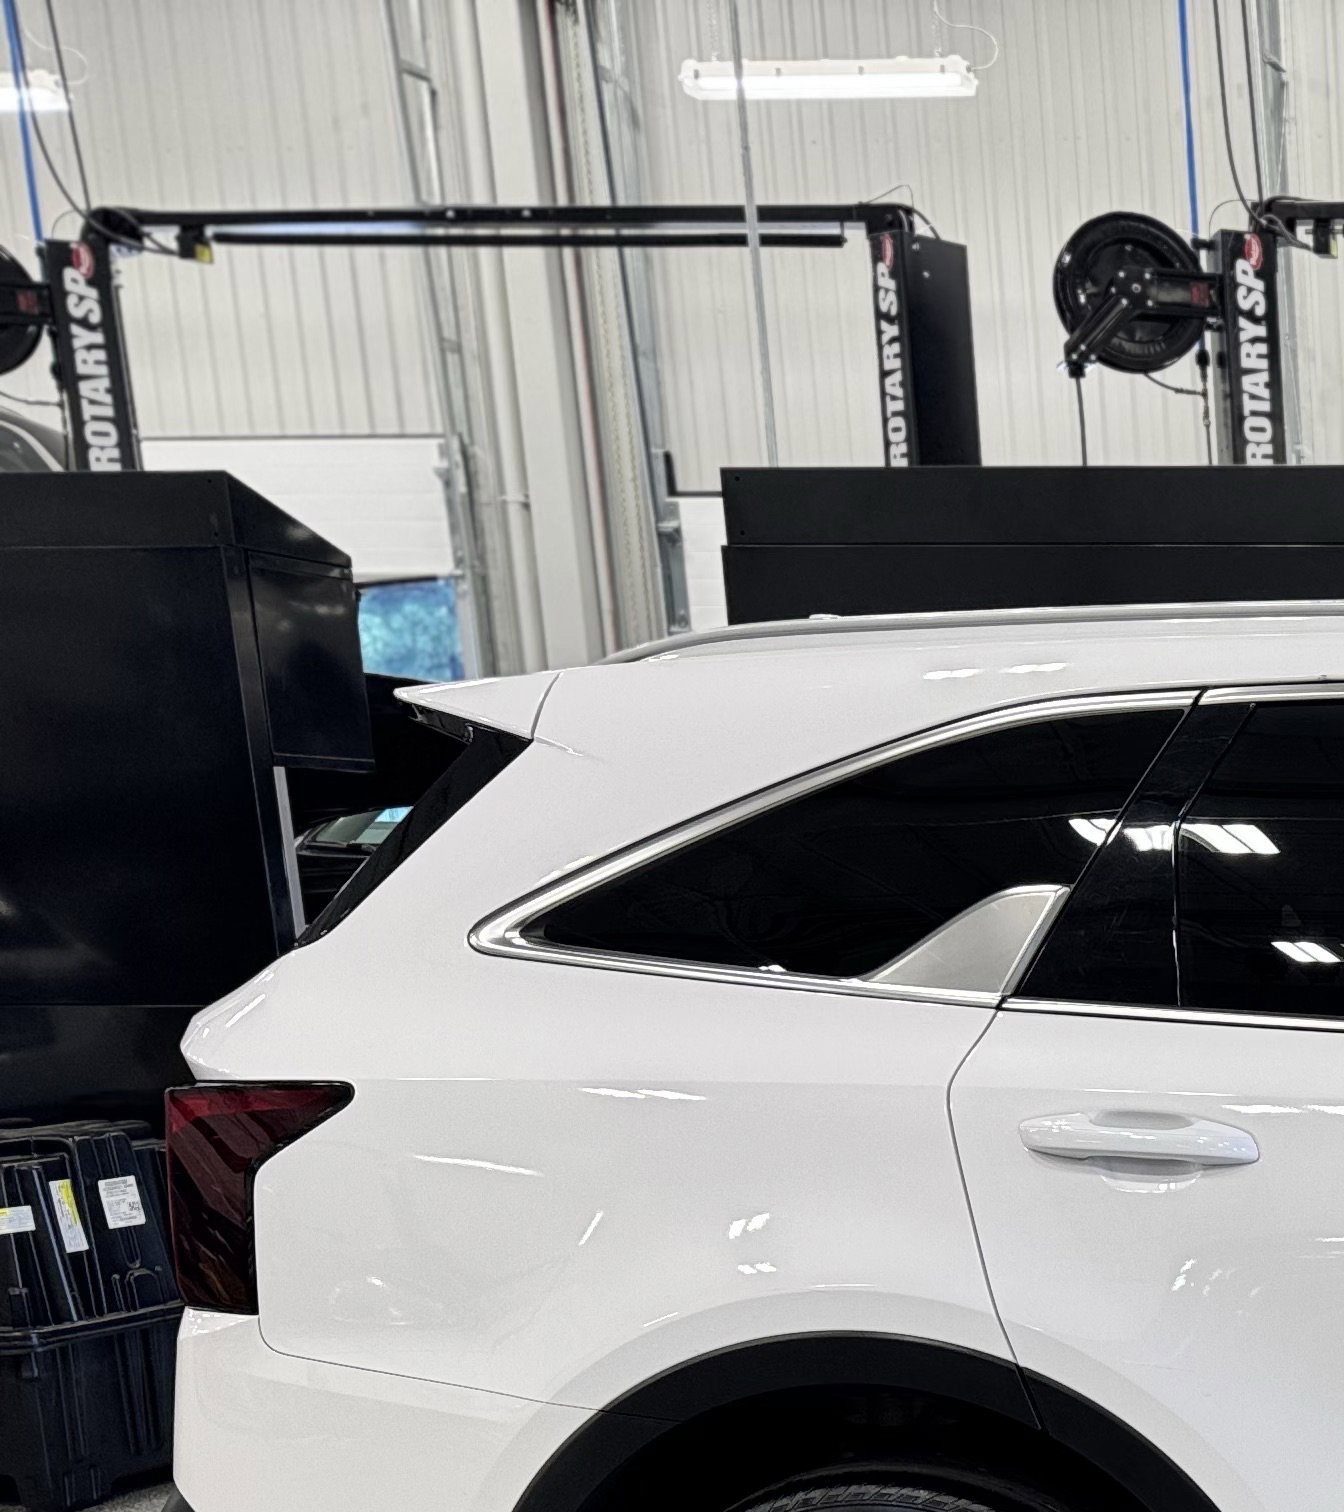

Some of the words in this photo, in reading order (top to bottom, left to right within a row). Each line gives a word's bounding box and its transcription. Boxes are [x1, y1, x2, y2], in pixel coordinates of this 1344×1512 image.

[62, 266, 103, 325] SP
[876, 261, 898, 317] SP
[1235, 258, 1267, 318] SP
[68, 324, 123, 472] ROTARY
[880, 319, 910, 468] ROTARY
[1238, 320, 1275, 465] ROTARY
